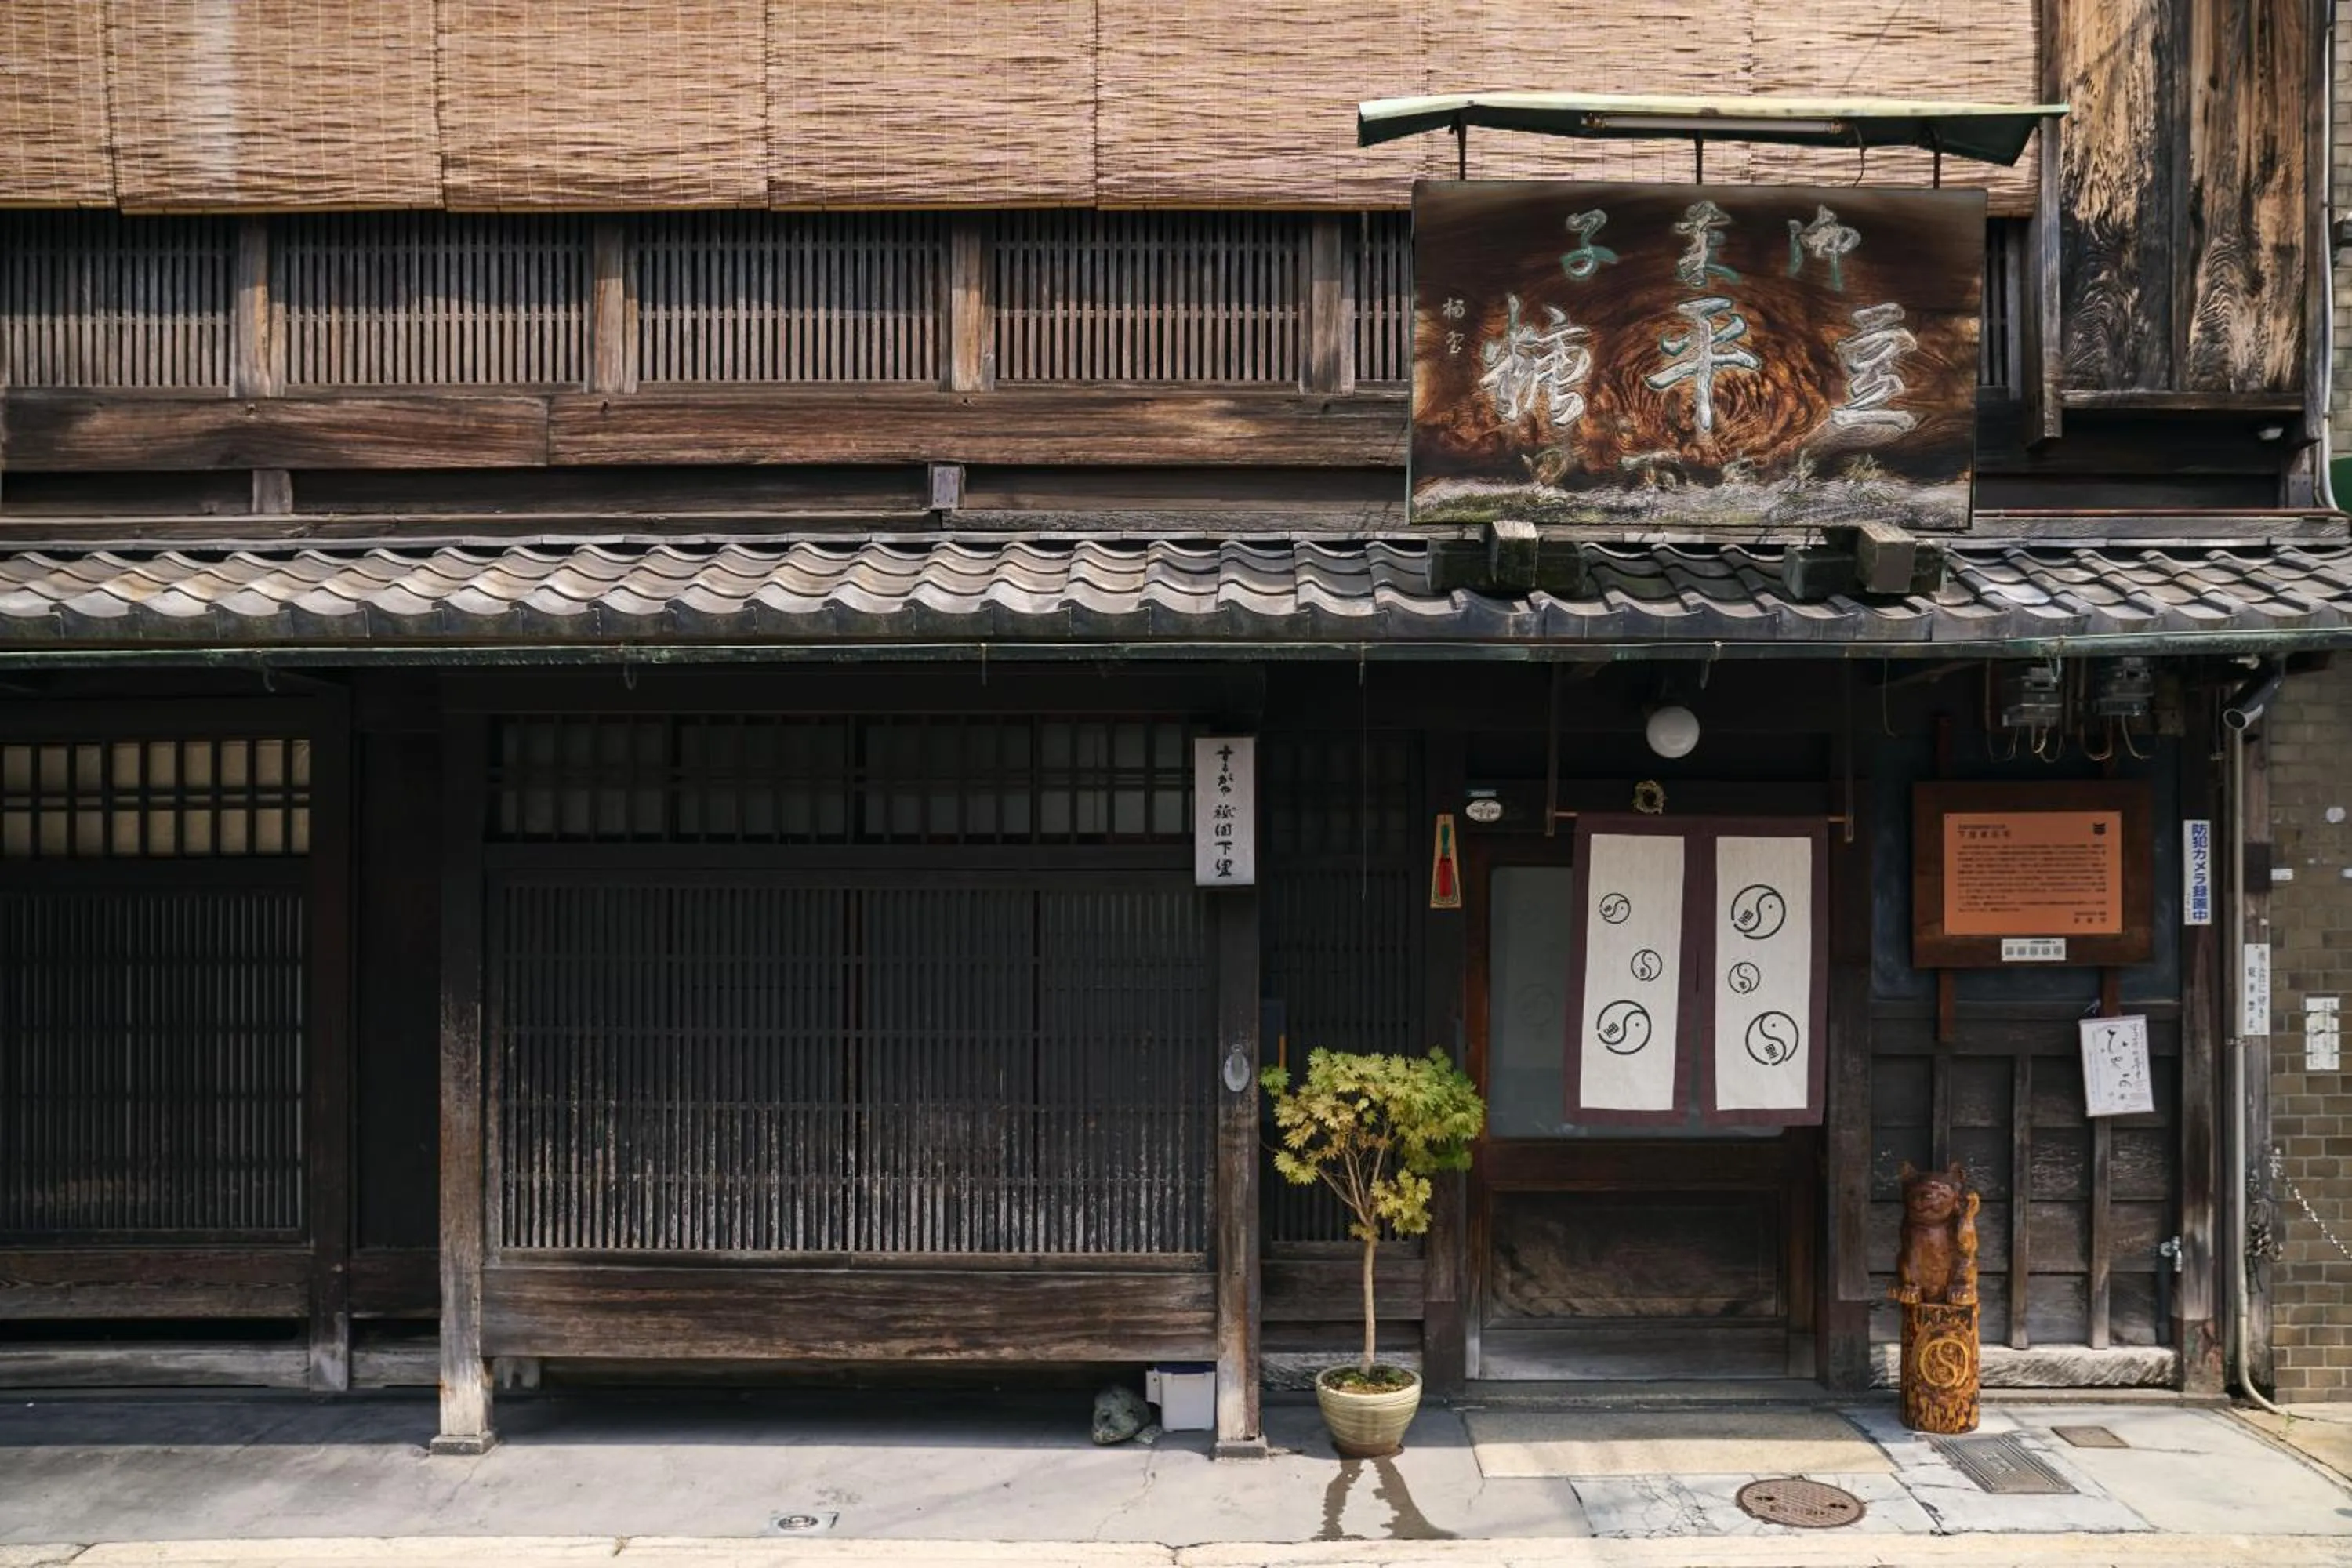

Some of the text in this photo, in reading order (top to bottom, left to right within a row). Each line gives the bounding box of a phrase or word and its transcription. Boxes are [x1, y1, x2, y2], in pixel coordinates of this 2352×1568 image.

[2191, 823, 2209, 922] 防犯カメラ録画中
